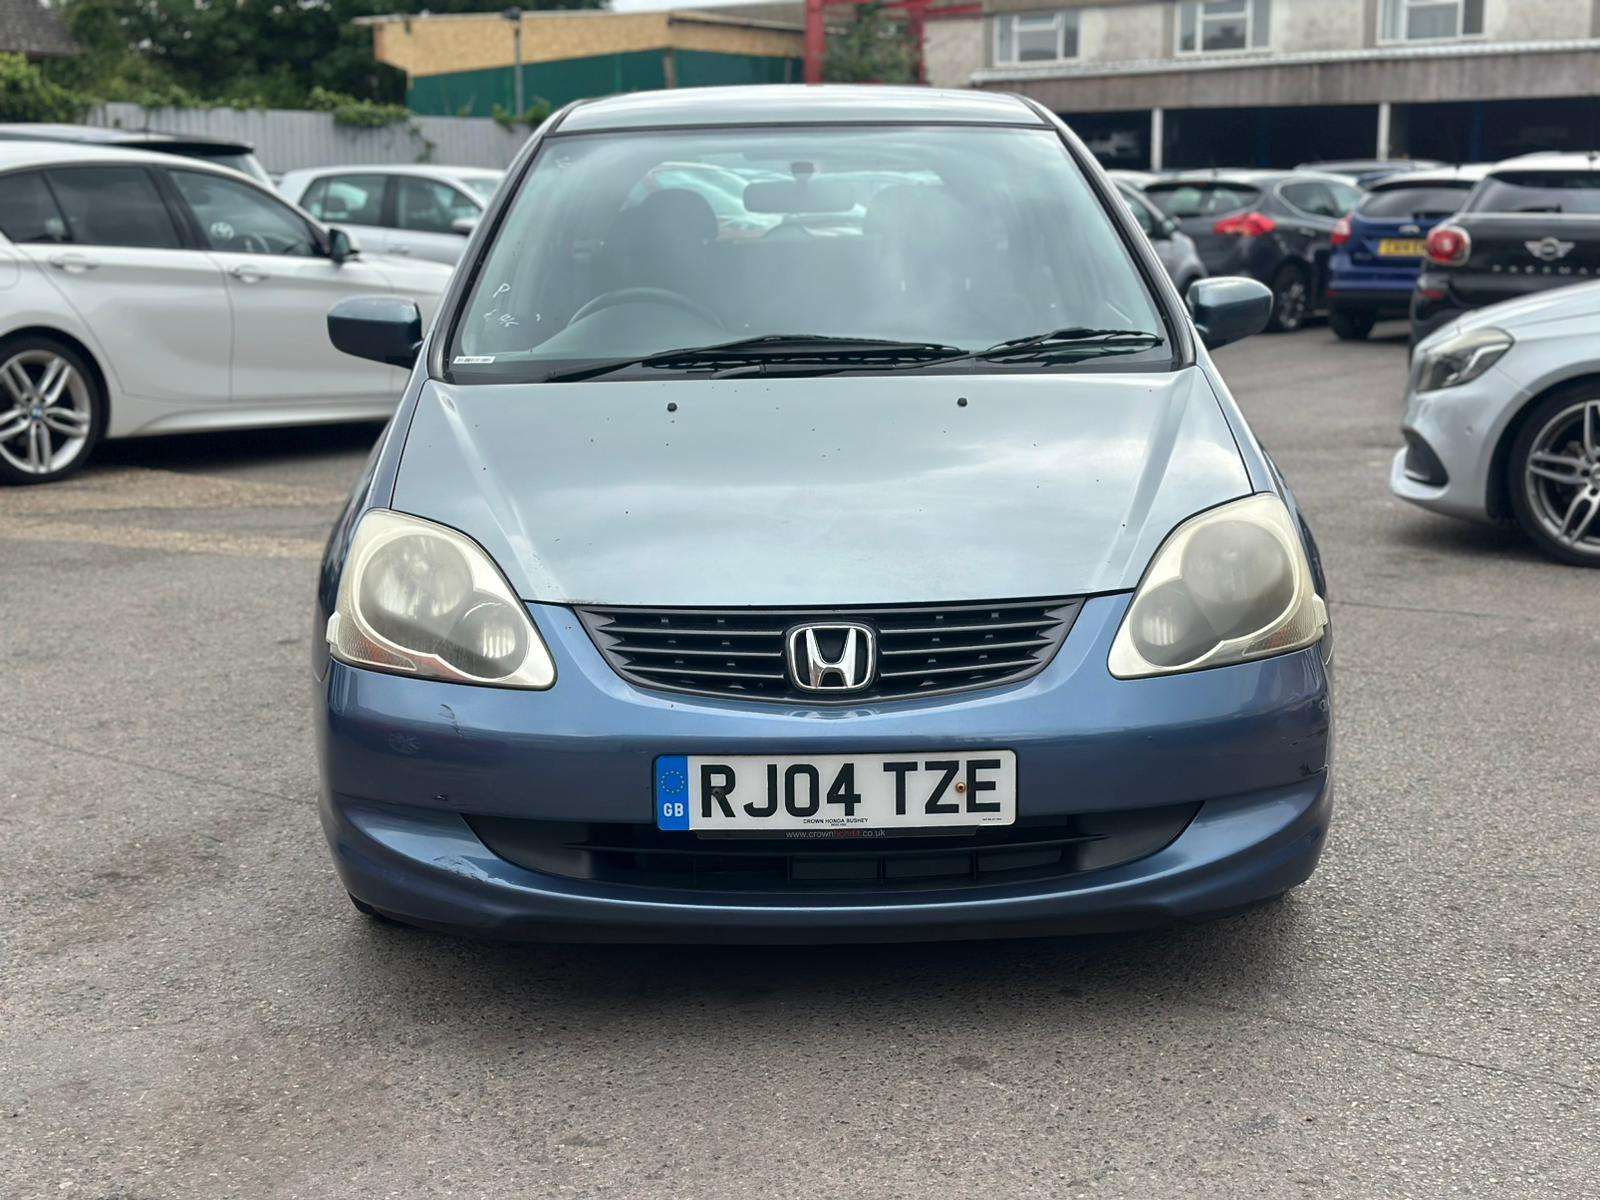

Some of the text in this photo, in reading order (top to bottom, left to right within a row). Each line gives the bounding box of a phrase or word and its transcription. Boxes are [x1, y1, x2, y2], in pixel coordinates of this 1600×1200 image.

[700, 760, 1001, 818] RJ04 TZE
[663, 802, 684, 817] GB
